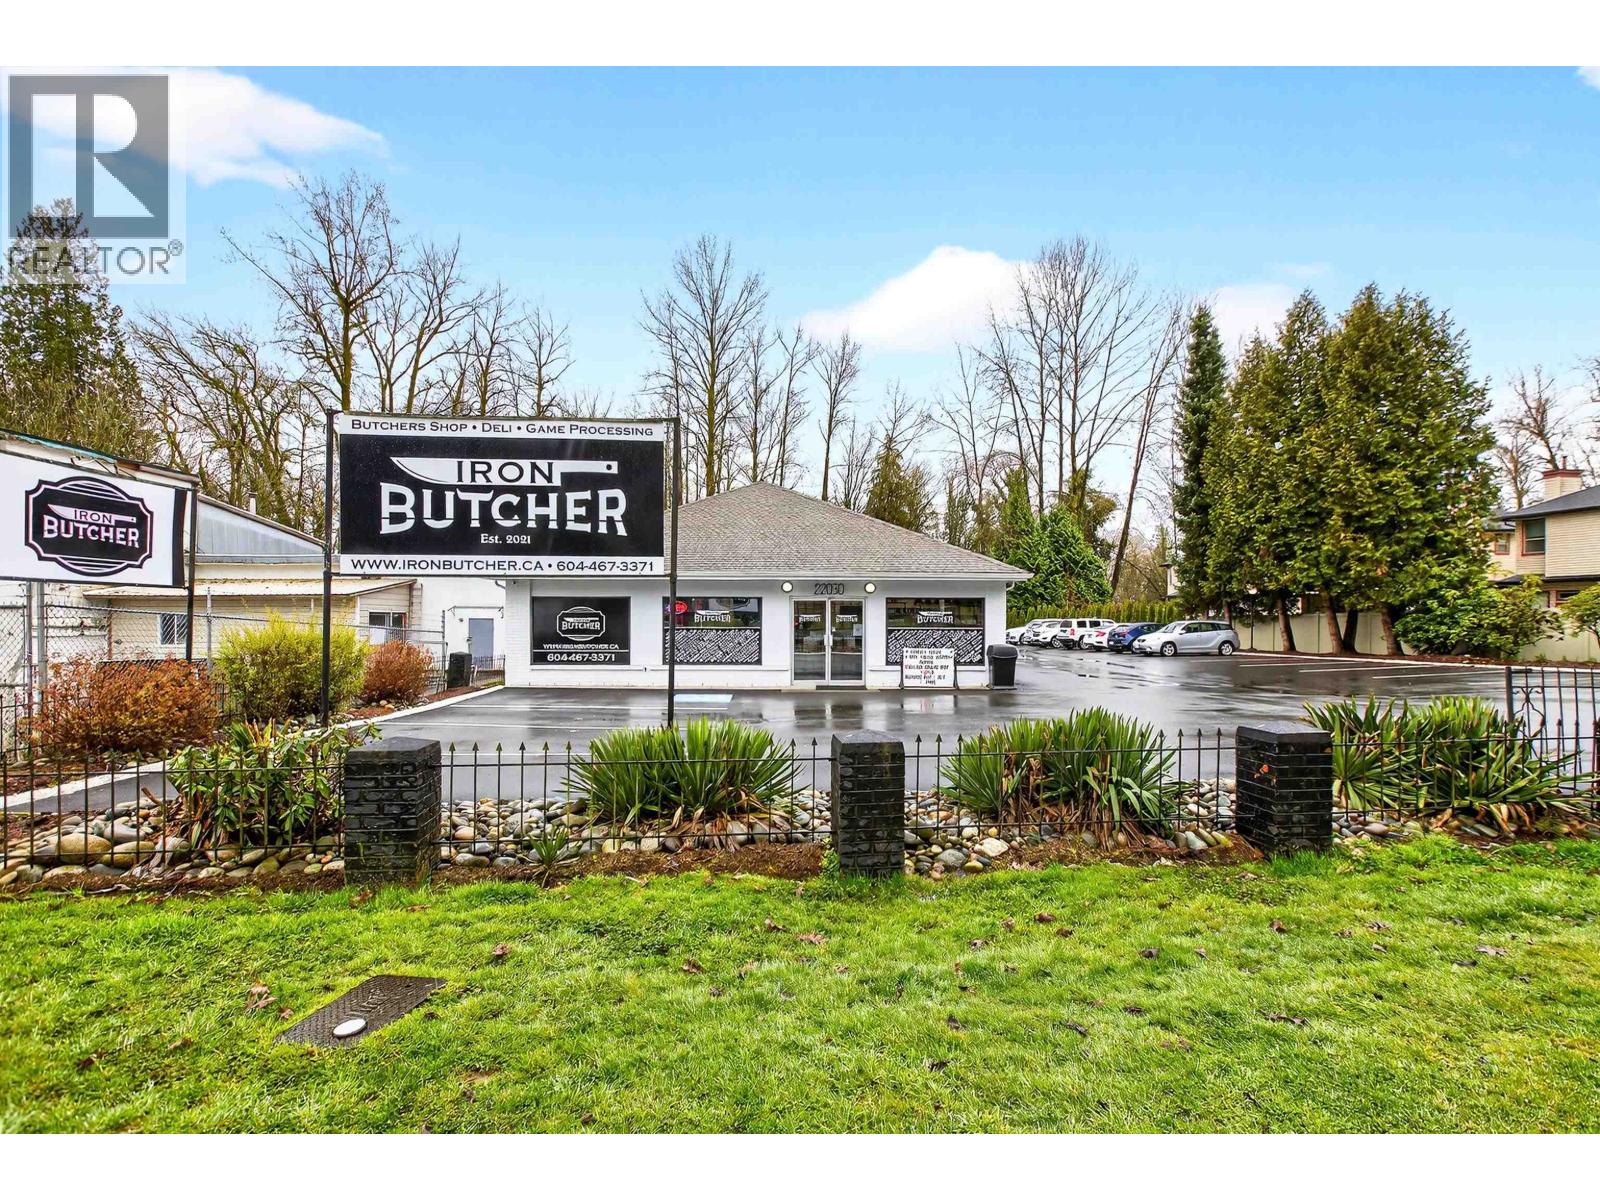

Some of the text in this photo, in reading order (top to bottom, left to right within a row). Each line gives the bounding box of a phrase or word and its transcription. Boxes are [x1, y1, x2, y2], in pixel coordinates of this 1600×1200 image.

[351, 419, 654, 437] BUTCHERS SHOP DELI GAME PROCESSING
[456, 460, 554, 484] IRON
[74, 509, 113, 524] IRON
[379, 482, 628, 537] BUTCHER
[43, 514, 140, 548] BUTCHER
[480, 533, 531, 544] Est. 2021
[351, 559, 654, 572] WWW.IRONBUTCHER.CA 604-467-3371
[561, 621, 601, 631] BUTCHER
